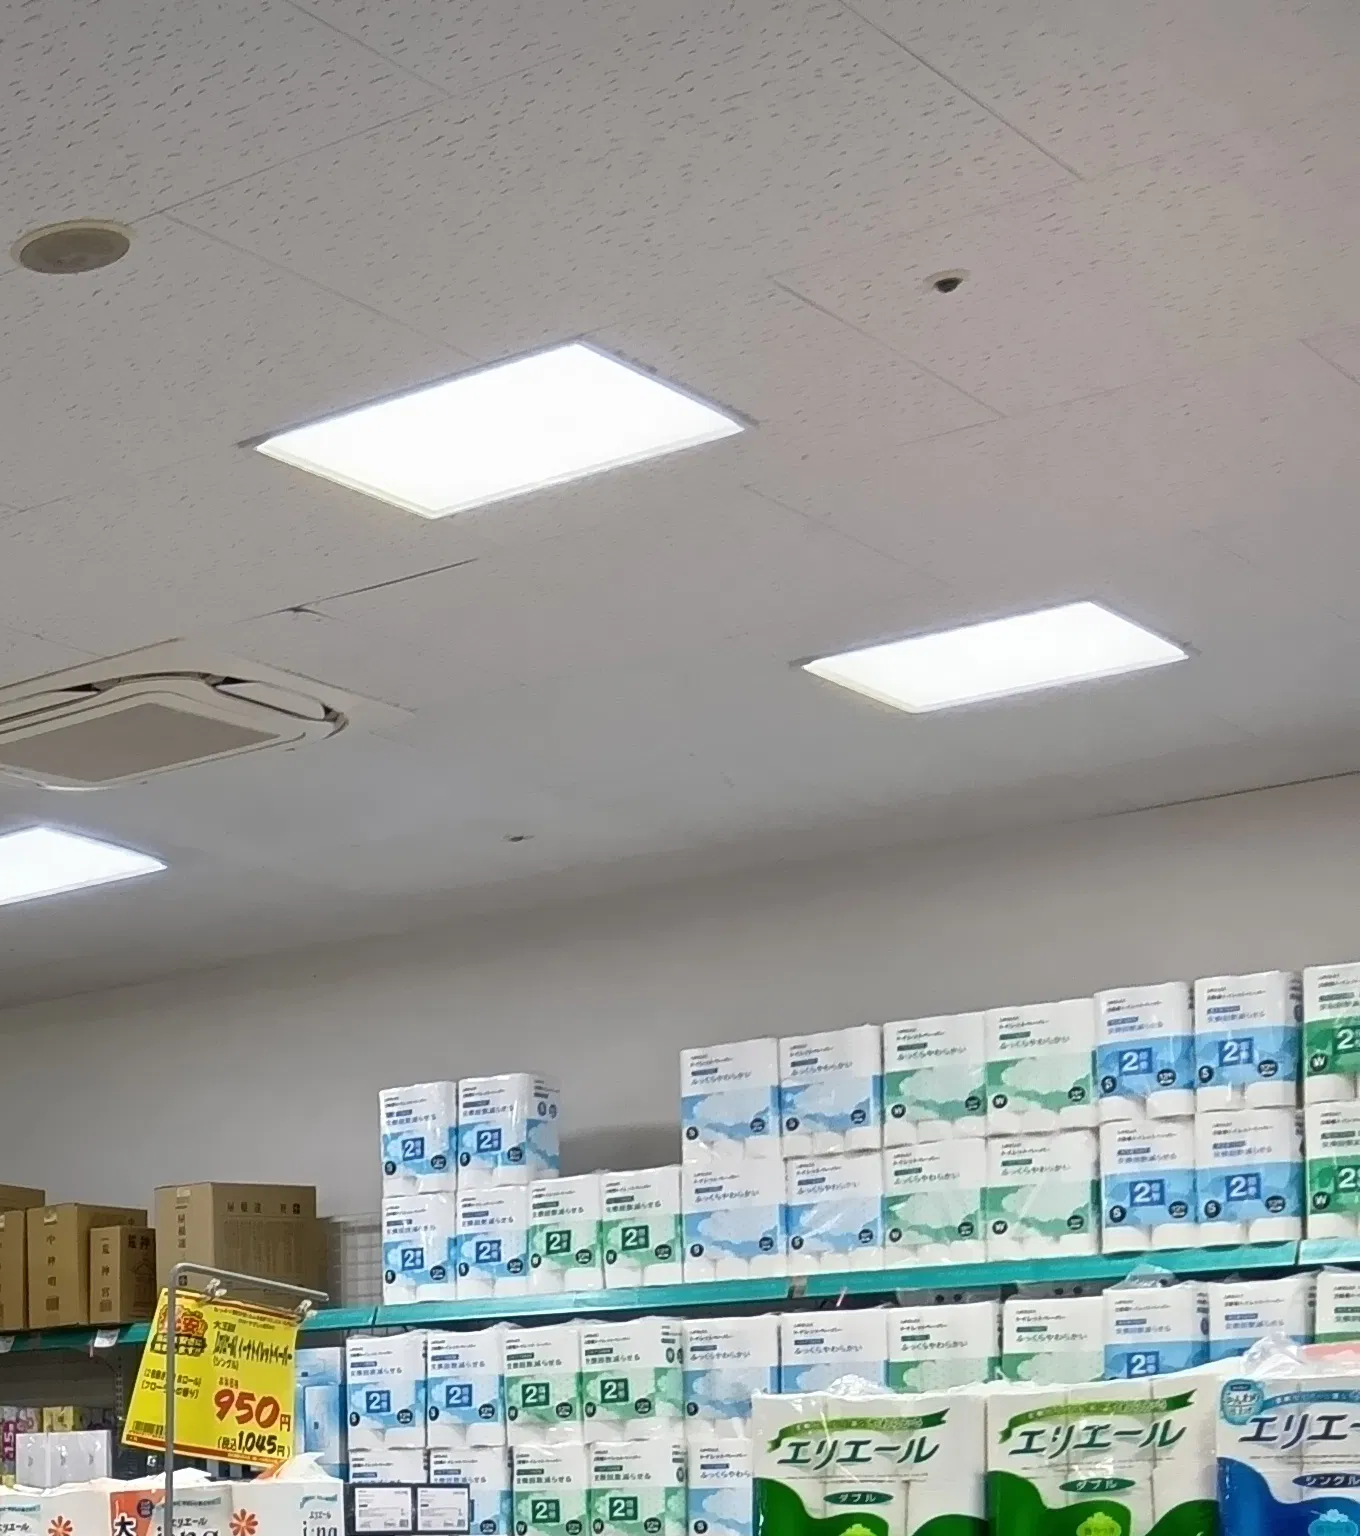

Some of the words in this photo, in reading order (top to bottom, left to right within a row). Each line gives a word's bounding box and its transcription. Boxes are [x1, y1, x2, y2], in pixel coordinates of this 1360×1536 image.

[1007, 1414, 1187, 1459] エリエール
[777, 1436, 942, 1470] エリエール
[1076, 1477, 1119, 1492] ダブル
[838, 1491, 877, 1505] ダブル
